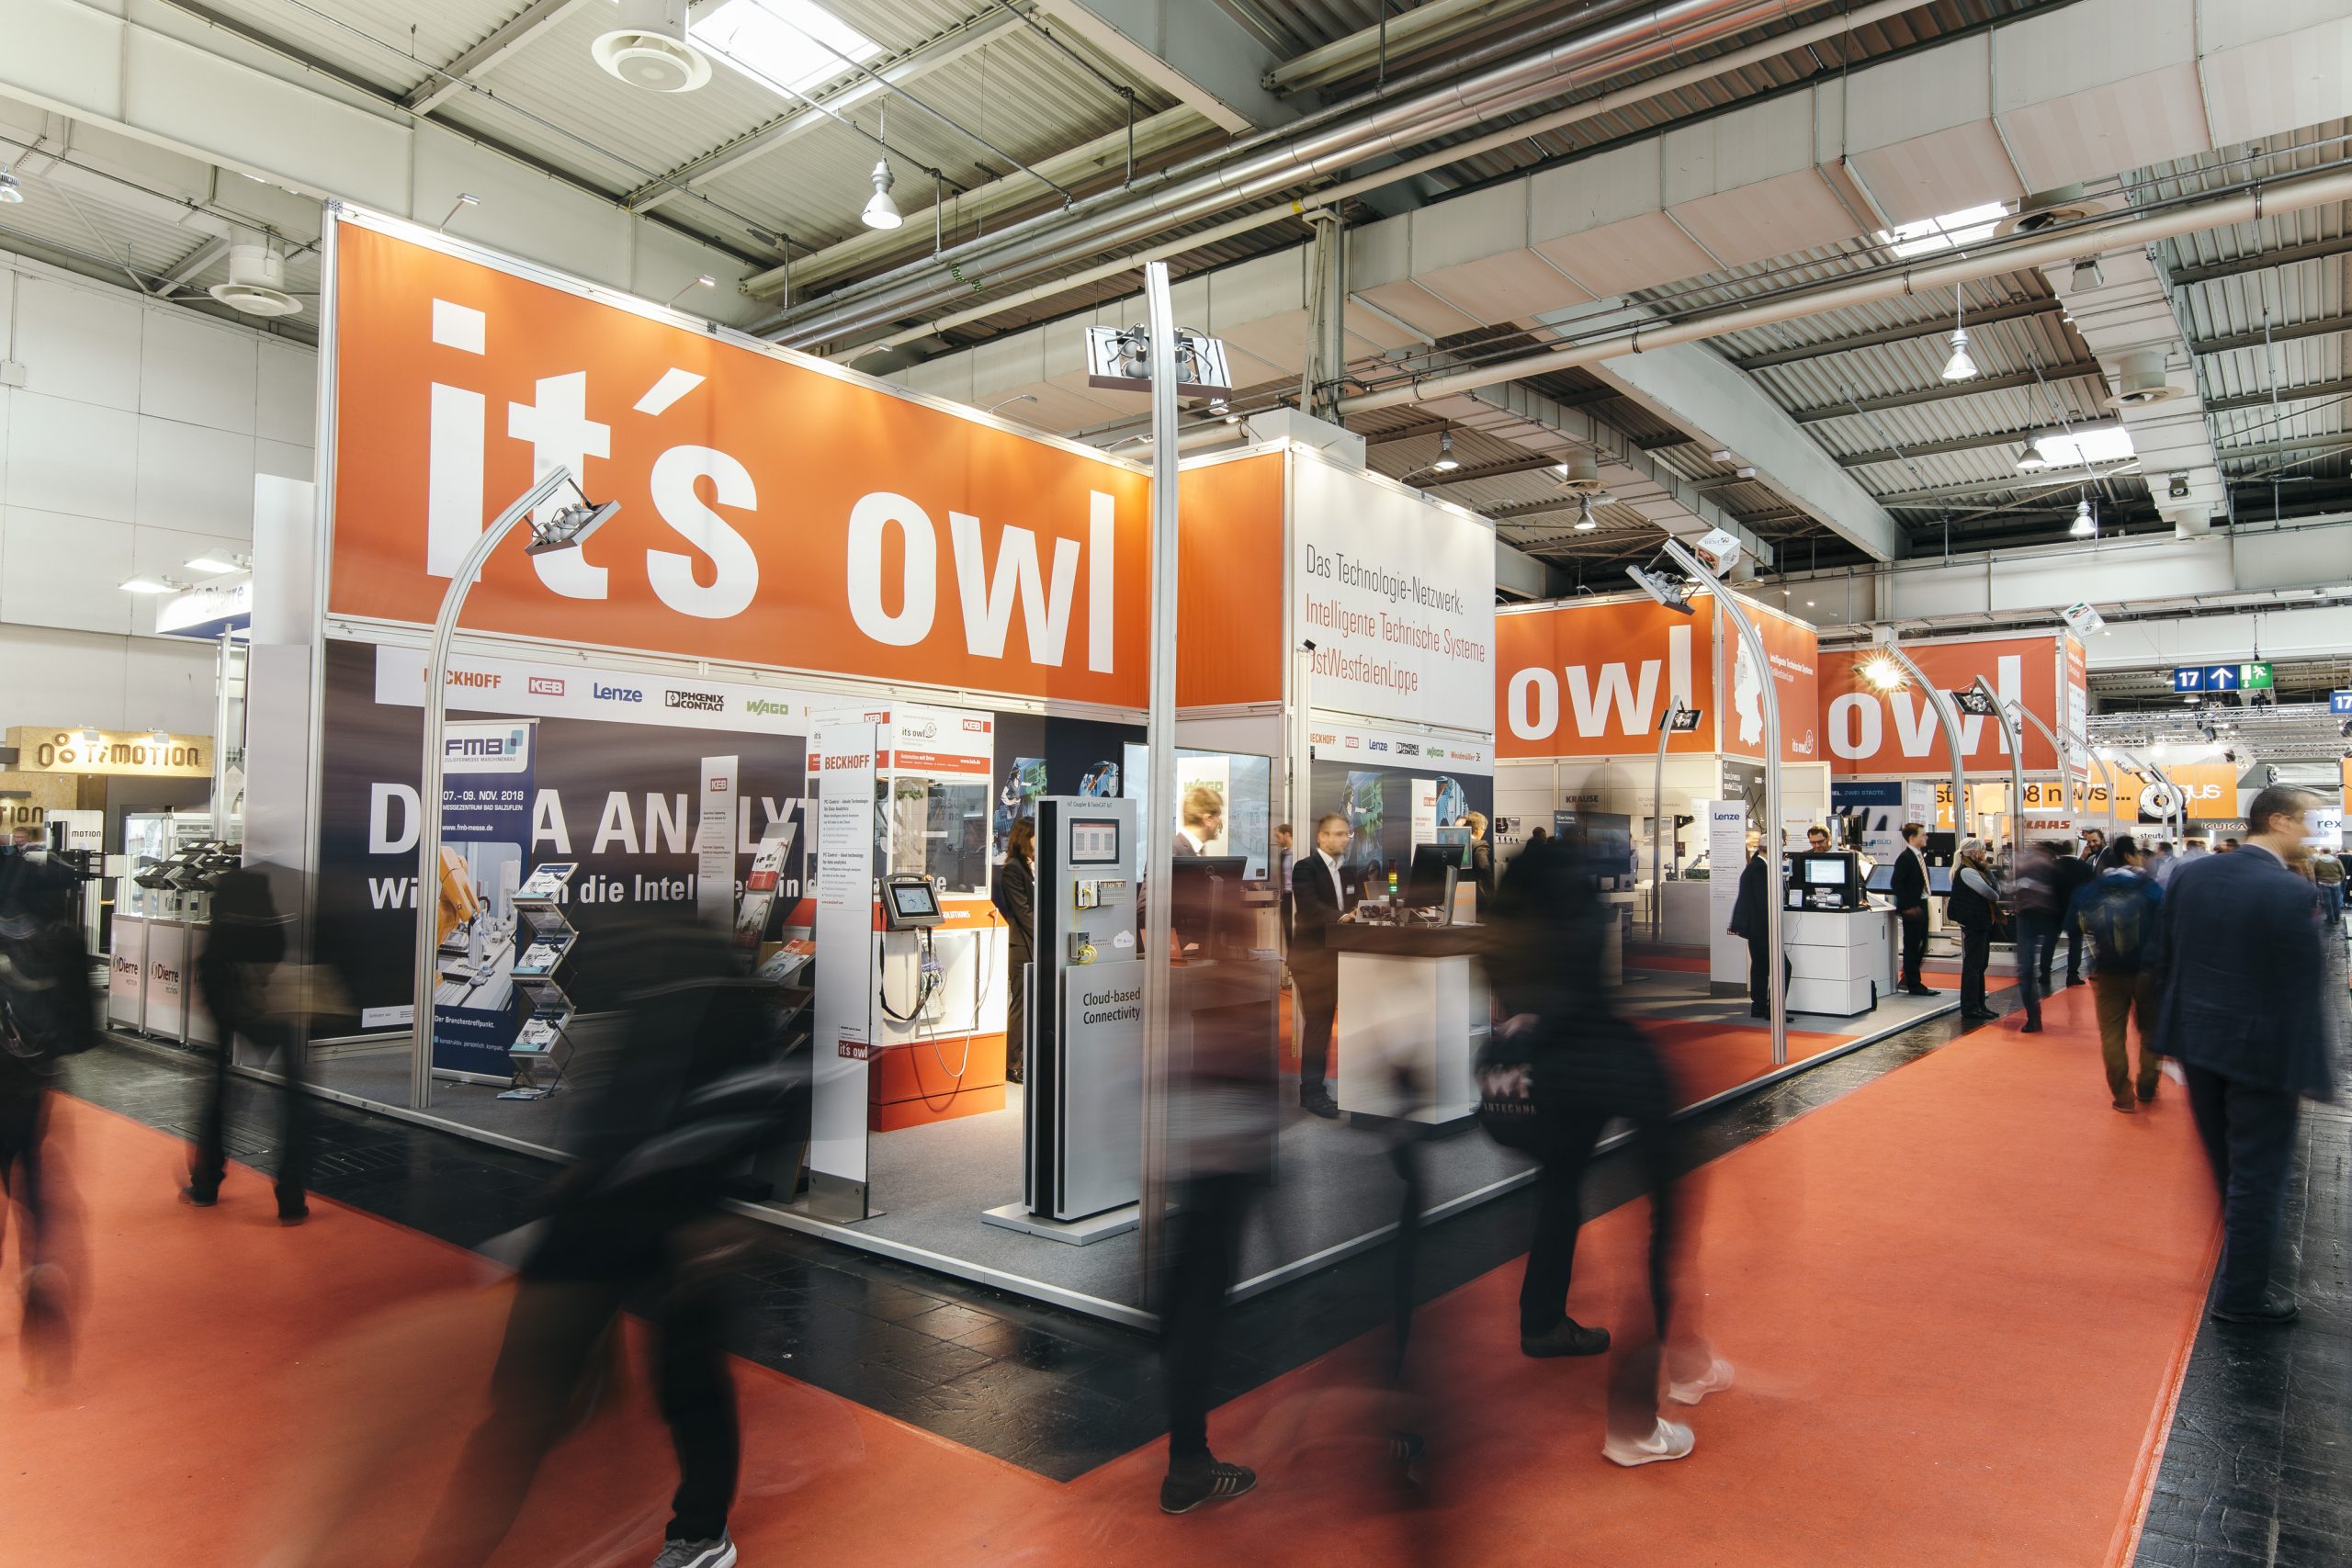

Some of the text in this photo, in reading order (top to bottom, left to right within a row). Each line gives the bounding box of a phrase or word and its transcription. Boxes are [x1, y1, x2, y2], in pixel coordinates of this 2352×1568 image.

[847, 490, 1115, 674] owl
[1306, 543, 1464, 615] Das Technologie-Netzwerk:
[1306, 592, 1485, 662] Intelligente Technische Systeme
[1508, 625, 1693, 740] owl
[2179, 671, 2199, 687] 17
[530, 679, 563, 695] KEB
[594, 682, 643, 703] Lenze
[746, 699, 789, 716] WAGO
[2335, 695, 2352, 709] 17
[681, 701, 724, 712] CONTACT
[1828, 655, 2022, 760] owl
[912, 729, 925, 738] owl
[963, 720, 981, 731] KEB
[446, 739, 503, 756] FMB
[1345, 738, 1359, 748] KEB
[1369, 739, 1388, 751] Lenze
[1427, 746, 1444, 759] WAGO
[1402, 749, 1419, 757] CONTACT
[825, 755, 870, 770] BECKHOFF
[711, 779, 727, 790] KEB
[1724, 773, 1741, 782] business
[479, 790, 498, 801] NOV.
[501, 791, 524, 801] 2018
[1566, 795, 1600, 804] KRAUSE
[1714, 812, 1740, 820] Lenze
[580, 874, 625, 904] die
[778, 876, 798, 897] in
[119, 956, 139, 975] Dierre
[157, 964, 179, 983] Dierre
[1083, 987, 1141, 1007] Cloud-based
[1083, 1006, 1141, 1025] Connectivity
[853, 1045, 868, 1059] owl
